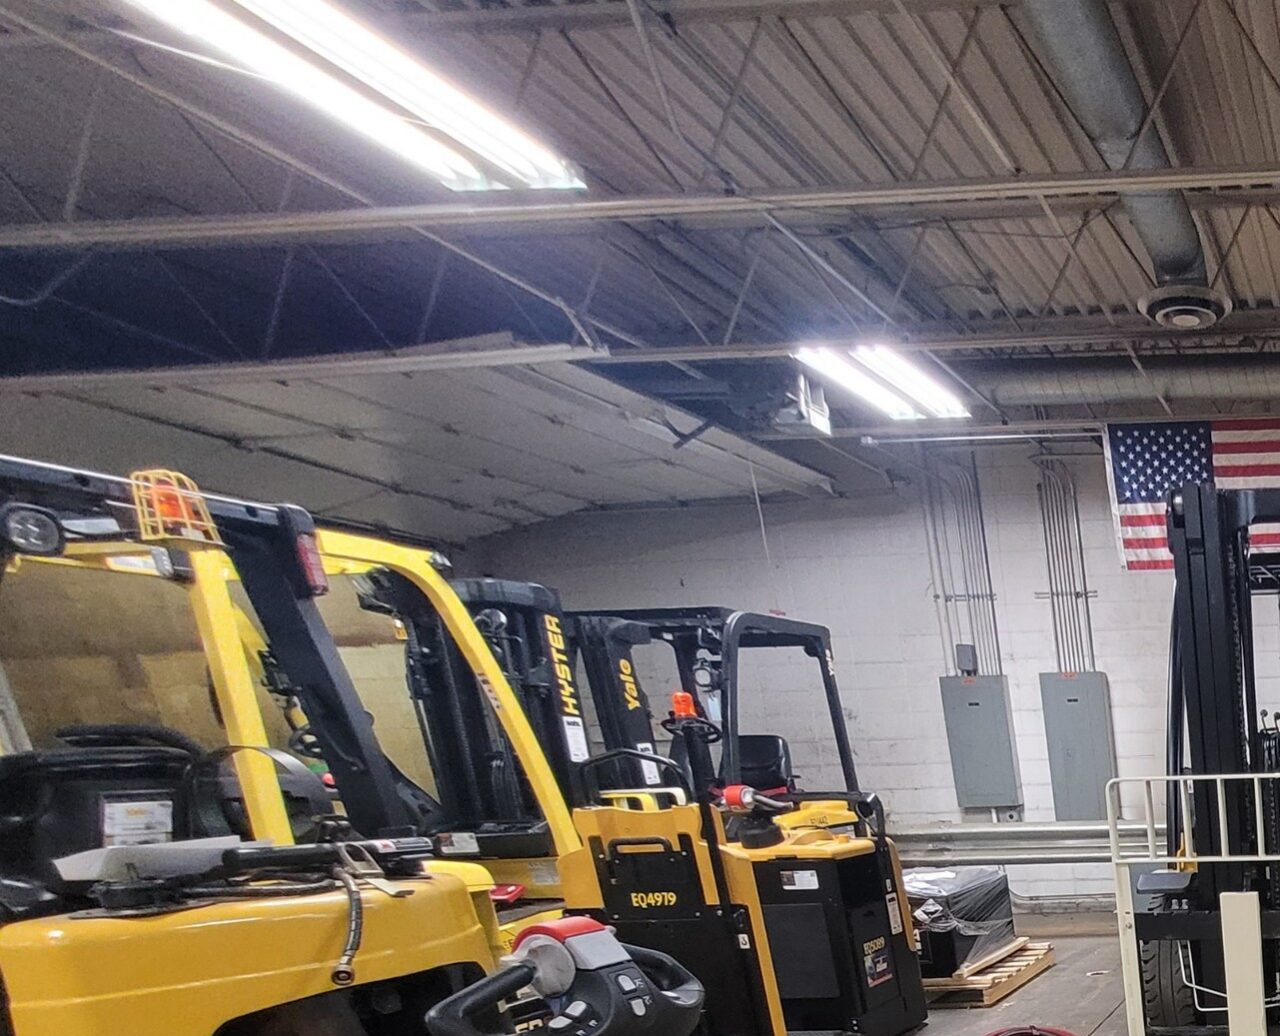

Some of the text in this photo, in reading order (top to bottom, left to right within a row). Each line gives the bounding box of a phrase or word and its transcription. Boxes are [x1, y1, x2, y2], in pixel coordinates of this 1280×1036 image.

[544, 614, 580, 716] HYSTER
[619, 658, 641, 711] Yale
[631, 891, 677, 908] EQ4979
